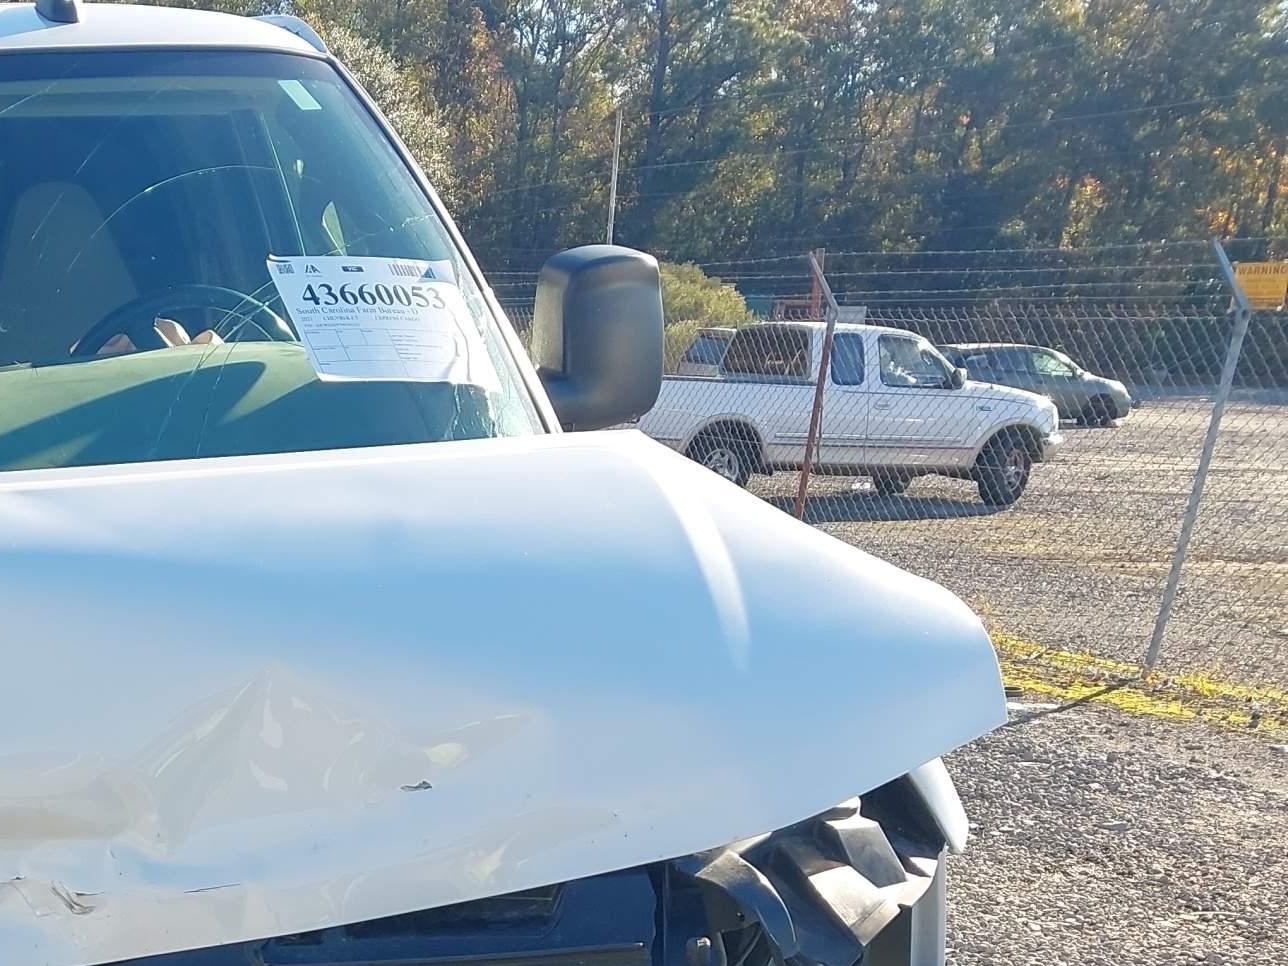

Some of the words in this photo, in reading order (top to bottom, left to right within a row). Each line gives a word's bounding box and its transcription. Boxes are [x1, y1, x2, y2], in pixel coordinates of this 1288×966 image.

[1238, 265, 1288, 275] WARNING
[302, 283, 446, 309] 43660053
[296, 306, 320, 315] South
[321, 306, 355, 314] Carolina
[356, 306, 377, 314] Farm
[378, 306, 405, 315] Bureau
